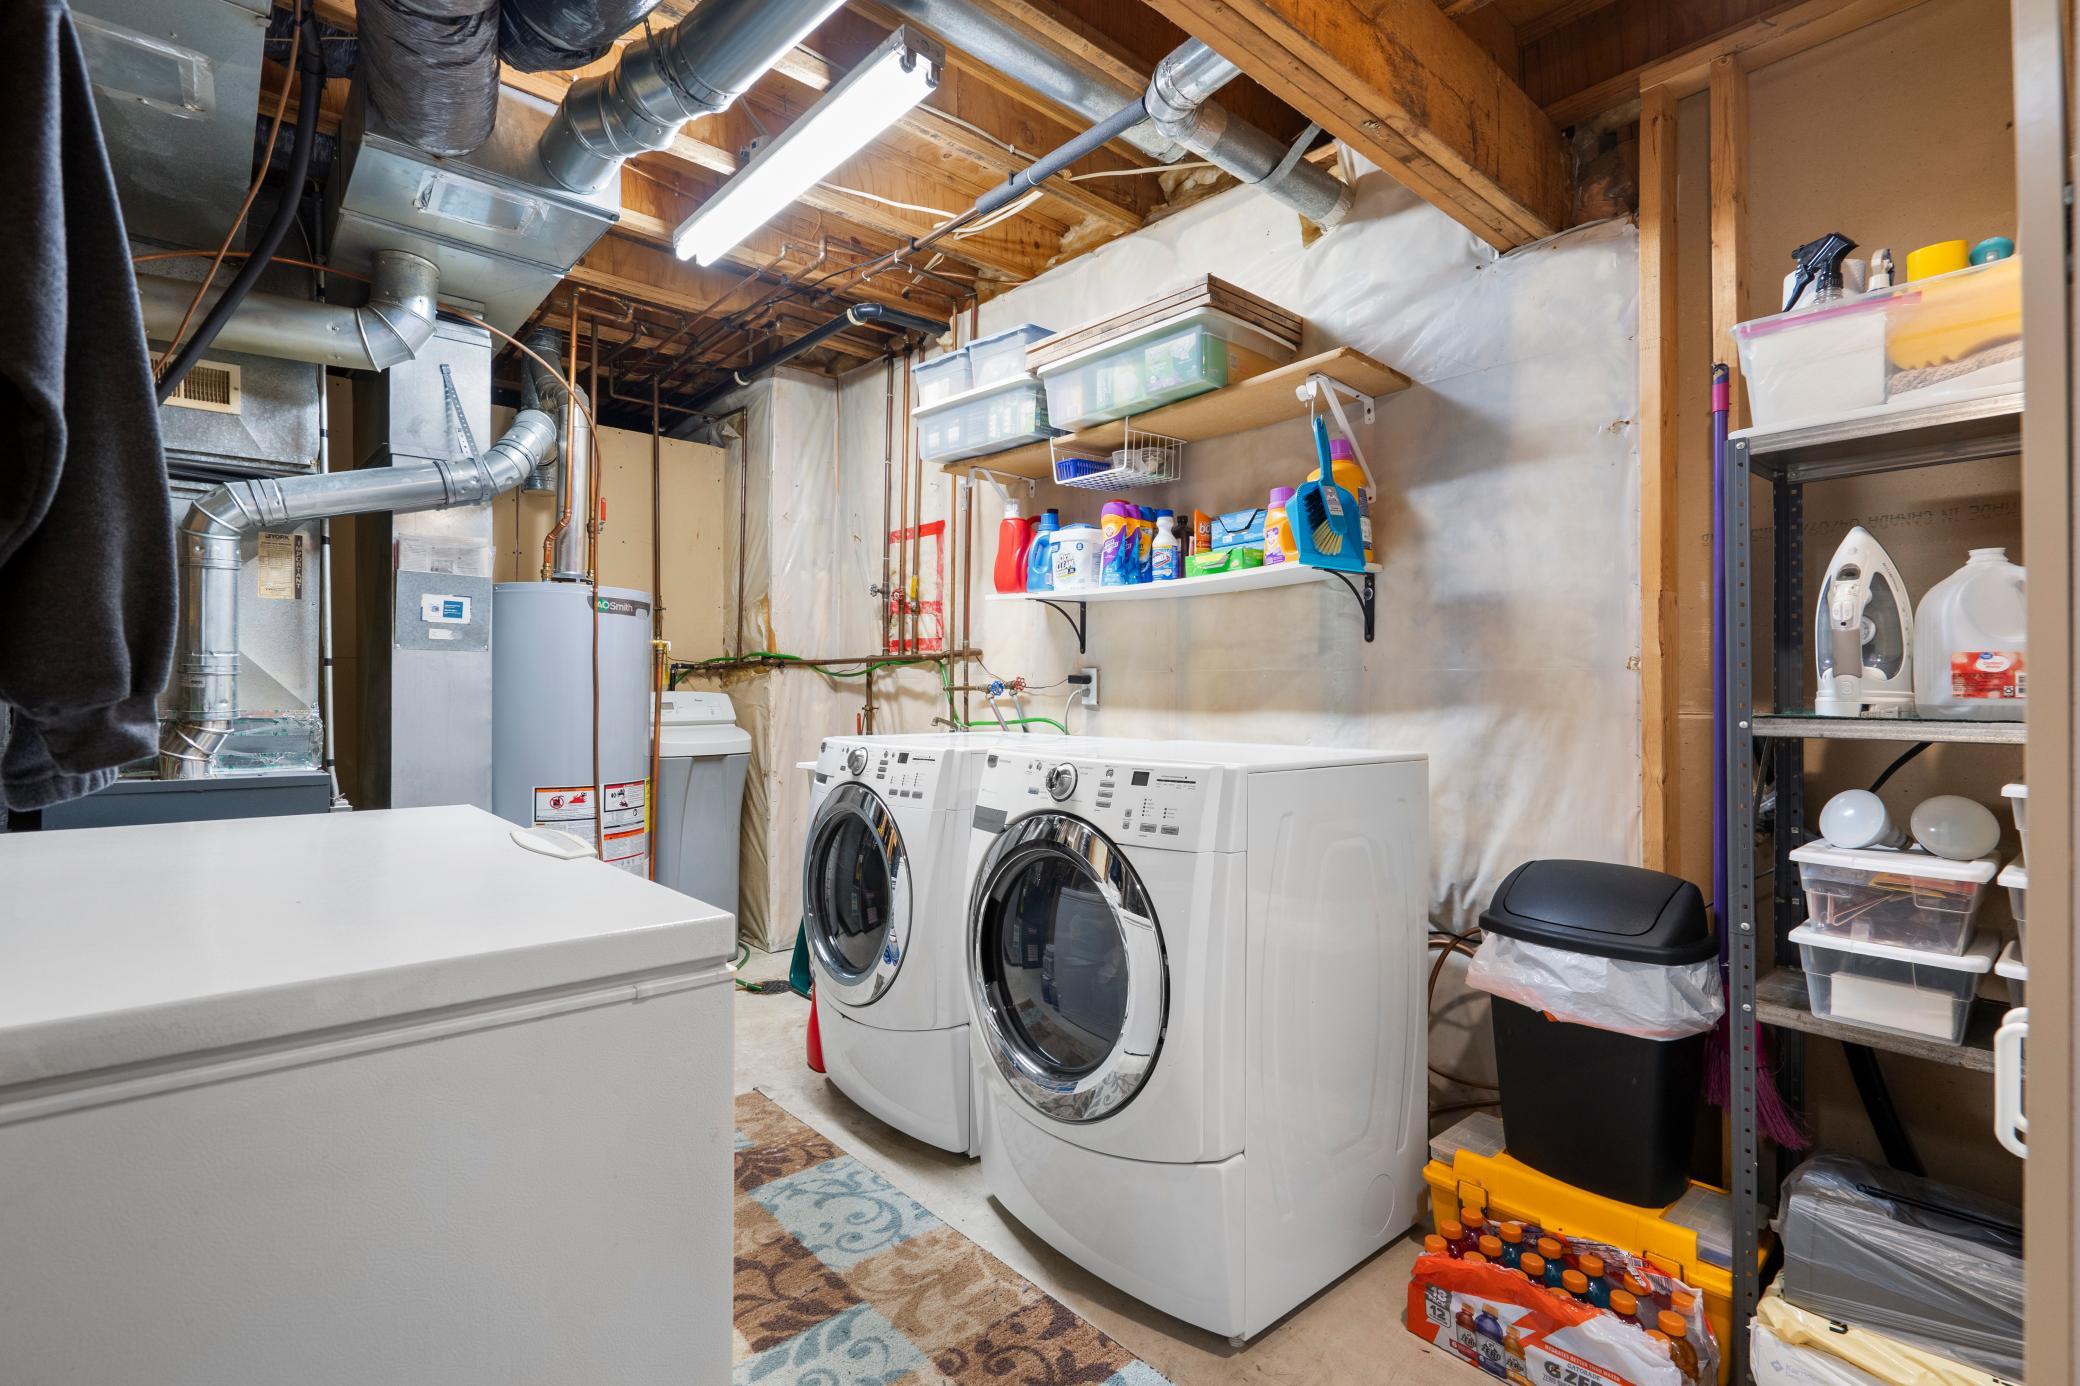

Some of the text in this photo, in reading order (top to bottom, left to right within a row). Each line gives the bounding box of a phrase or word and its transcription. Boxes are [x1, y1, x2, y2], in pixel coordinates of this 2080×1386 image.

[1868, 510, 1935, 529] CANADA
[609, 601, 633, 612] Smith
[1430, 1286, 1447, 1302] 18
[1429, 1304, 1446, 1322] 12
[1481, 1343, 1501, 1362] ZERO
[1544, 1344, 1570, 1360] HYDRATES
[1569, 1356, 1589, 1368] BETTER
[1566, 1362, 1602, 1382] GATORADE
